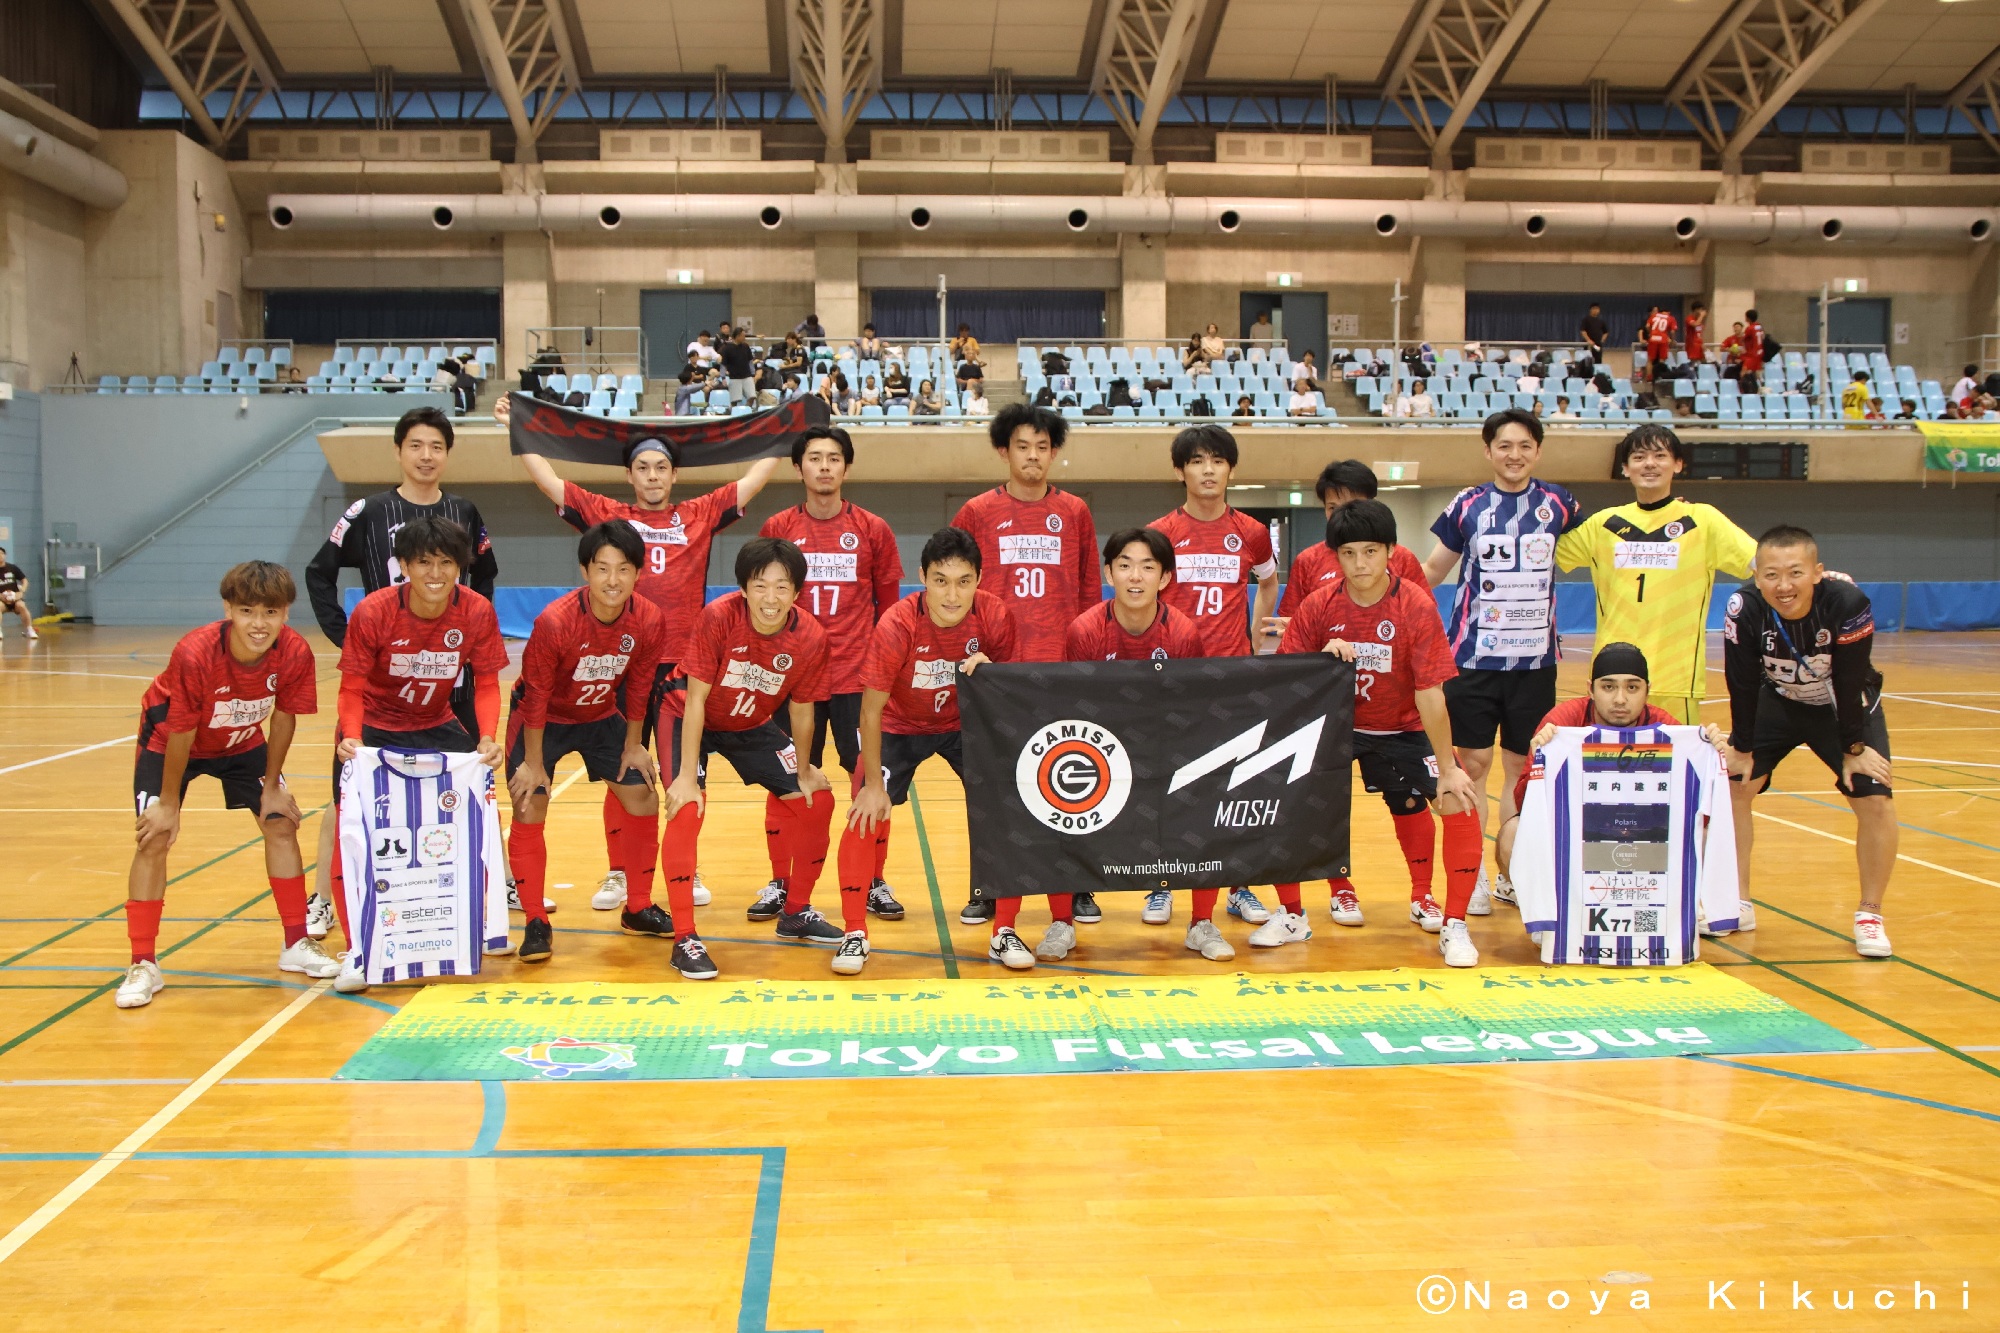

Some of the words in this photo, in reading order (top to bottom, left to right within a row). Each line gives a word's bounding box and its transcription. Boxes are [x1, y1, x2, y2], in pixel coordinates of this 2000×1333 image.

[1651, 316, 1668, 332] 70
[1482, 514, 1496, 528] 21
[1015, 536, 1059, 548] けいじゅ
[1629, 543, 1677, 554] けいじゅ
[650, 546, 666, 574] 9
[809, 554, 855, 566] けいじゅ
[1017, 547, 1052, 560] 整骨院
[1193, 556, 1238, 567] けいじゅ
[811, 565, 848, 578] 整骨院
[1196, 566, 1231, 579] 整骨院
[1014, 567, 1045, 598] 30
[1636, 573, 1645, 602] 1
[809, 585, 840, 616] 17
[1192, 585, 1223, 616] 79
[1505, 608, 1546, 618] asteria
[1501, 636, 1545, 646] marumoto
[1766, 636, 1775, 651] 5
[398, 681, 437, 705] 47
[575, 683, 611, 705] 22
[729, 691, 756, 718] 14
[226, 726, 257, 748] 10
[1031, 725, 1116, 757] CAMISA
[1588, 781, 1668, 792] 河内建設
[375, 803, 391, 820] 47
[1214, 799, 1280, 827] MOSH
[1048, 811, 1103, 829] 2002
[1614, 818, 1638, 826] Polaris
[1103, 859, 1222, 875] www.moshtokyo.com
[1608, 875, 1658, 887] けいじゅ
[1610, 886, 1650, 900] 整骨院
[401, 904, 452, 920] asteria
[399, 939, 452, 951] marumoto
[456, 994, 682, 1006] ATHLETA
[719, 991, 937, 1004] ATHLETA
[1236, 978, 1444, 997] ATHLETA
[1482, 975, 1692, 989] ATHLETA
[707, 1040, 1019, 1072] Tokyo
[1051, 1030, 1344, 1063] Futsal
[1361, 1026, 1713, 1057] League
